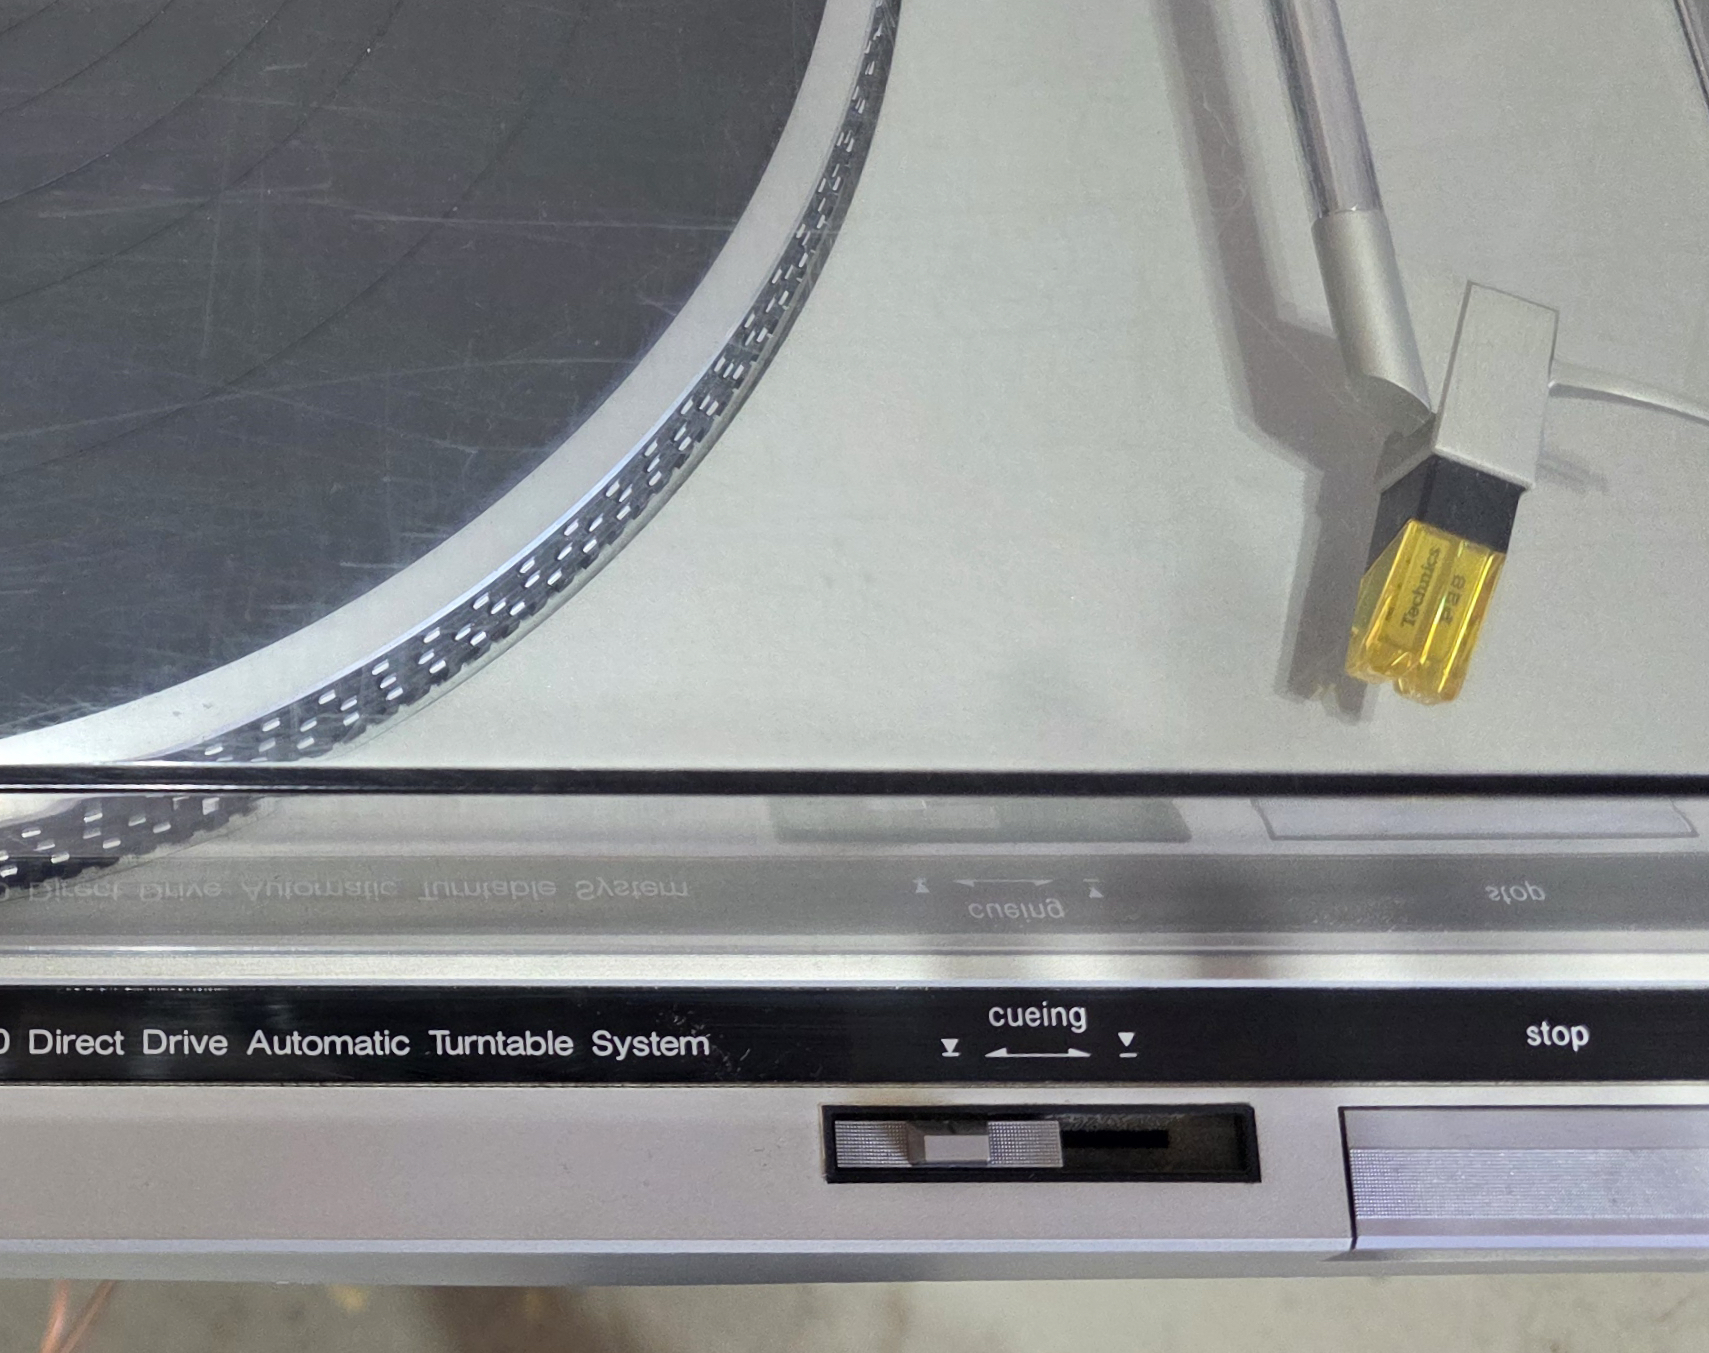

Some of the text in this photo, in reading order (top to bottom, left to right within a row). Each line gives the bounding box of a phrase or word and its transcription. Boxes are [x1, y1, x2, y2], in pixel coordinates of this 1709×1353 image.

[1399, 545, 1441, 628] Technics
[988, 1000, 1087, 1034] cueing
[28, 1028, 125, 1056] Direct
[142, 1028, 229, 1056] Drive
[246, 1029, 411, 1056] Automatic
[427, 1029, 574, 1057] Turntable
[591, 1029, 710, 1061] System
[1526, 1020, 1590, 1052] stop
